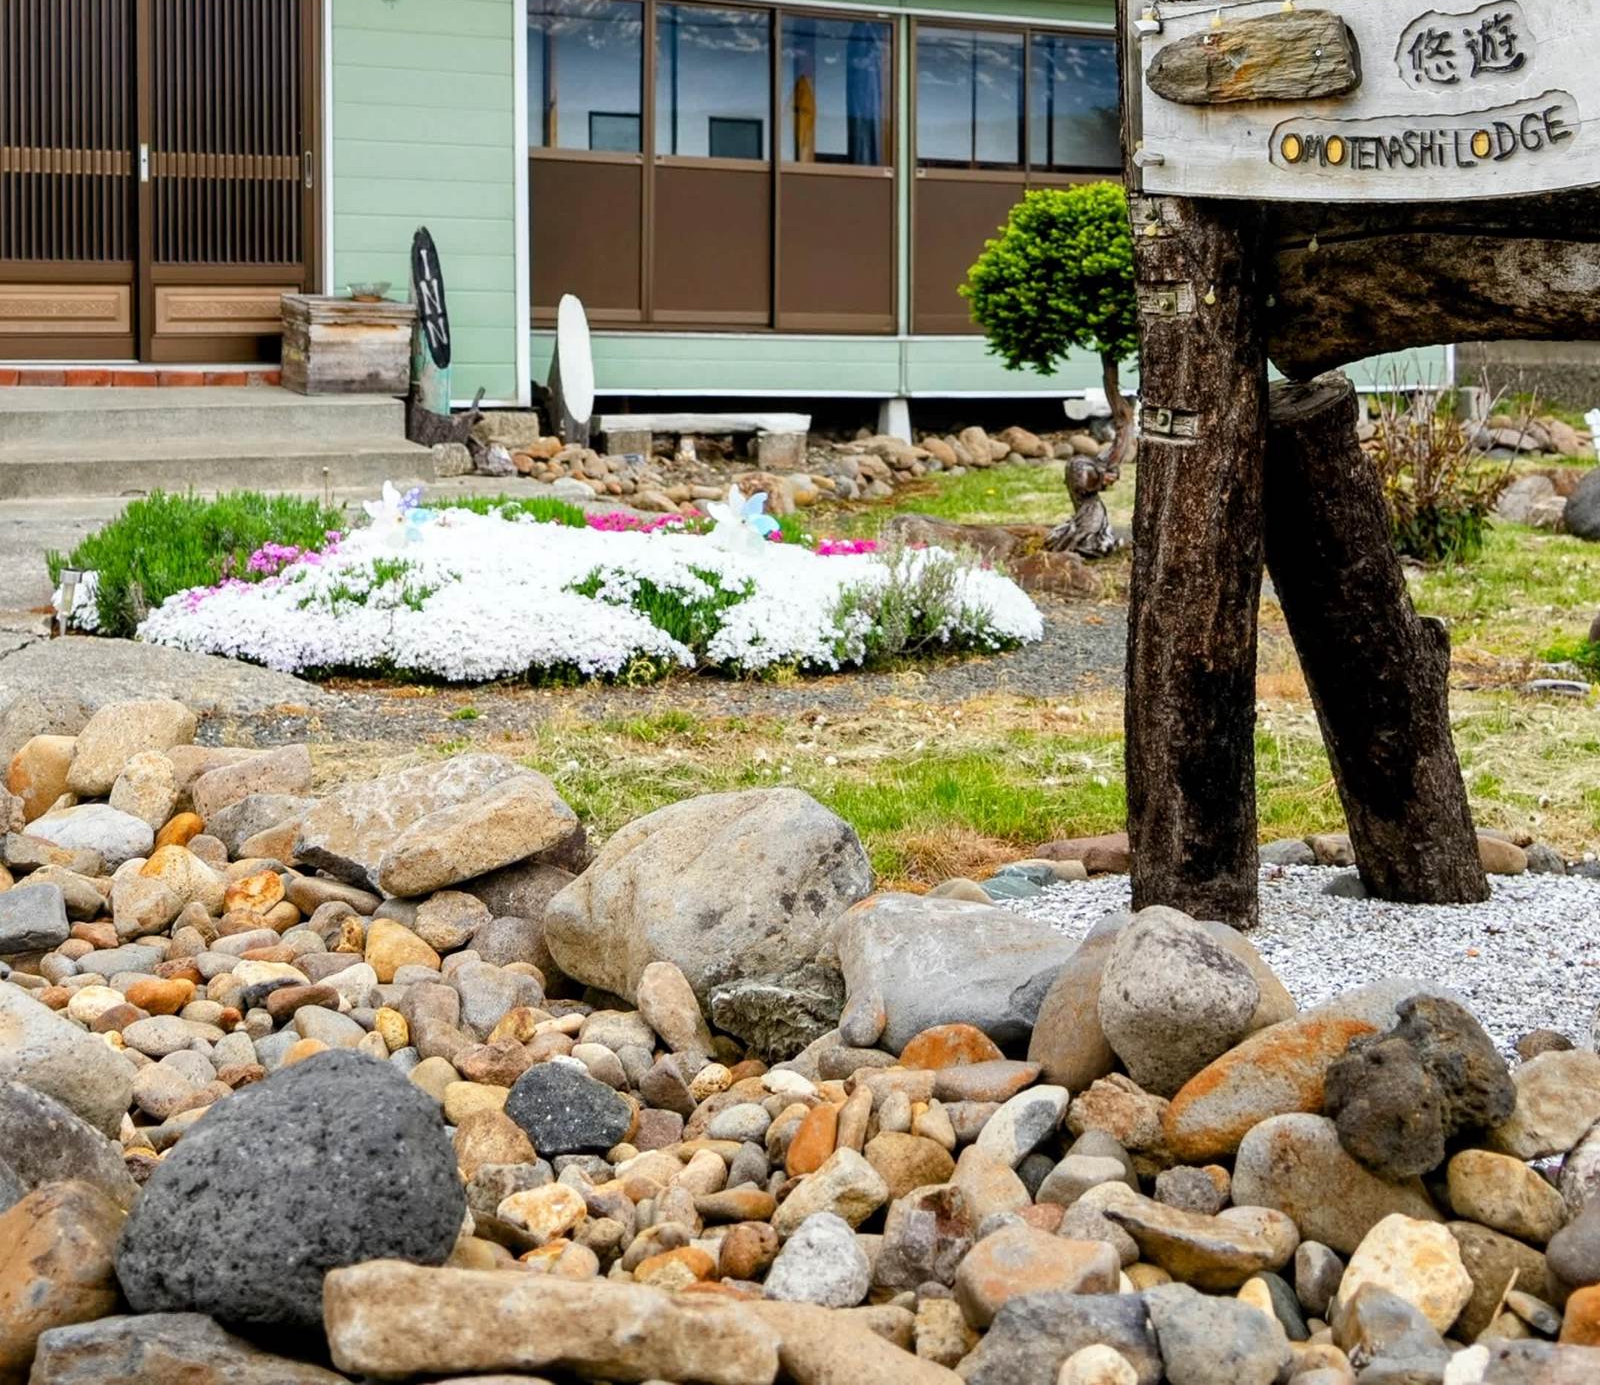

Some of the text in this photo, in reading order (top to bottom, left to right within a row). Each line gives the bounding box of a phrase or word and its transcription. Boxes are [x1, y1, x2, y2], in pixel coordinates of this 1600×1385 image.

[1408, 13, 1528, 84] 悠遊
[1454, 105, 1573, 167] LODGE
[420, 249, 448, 348] INN
